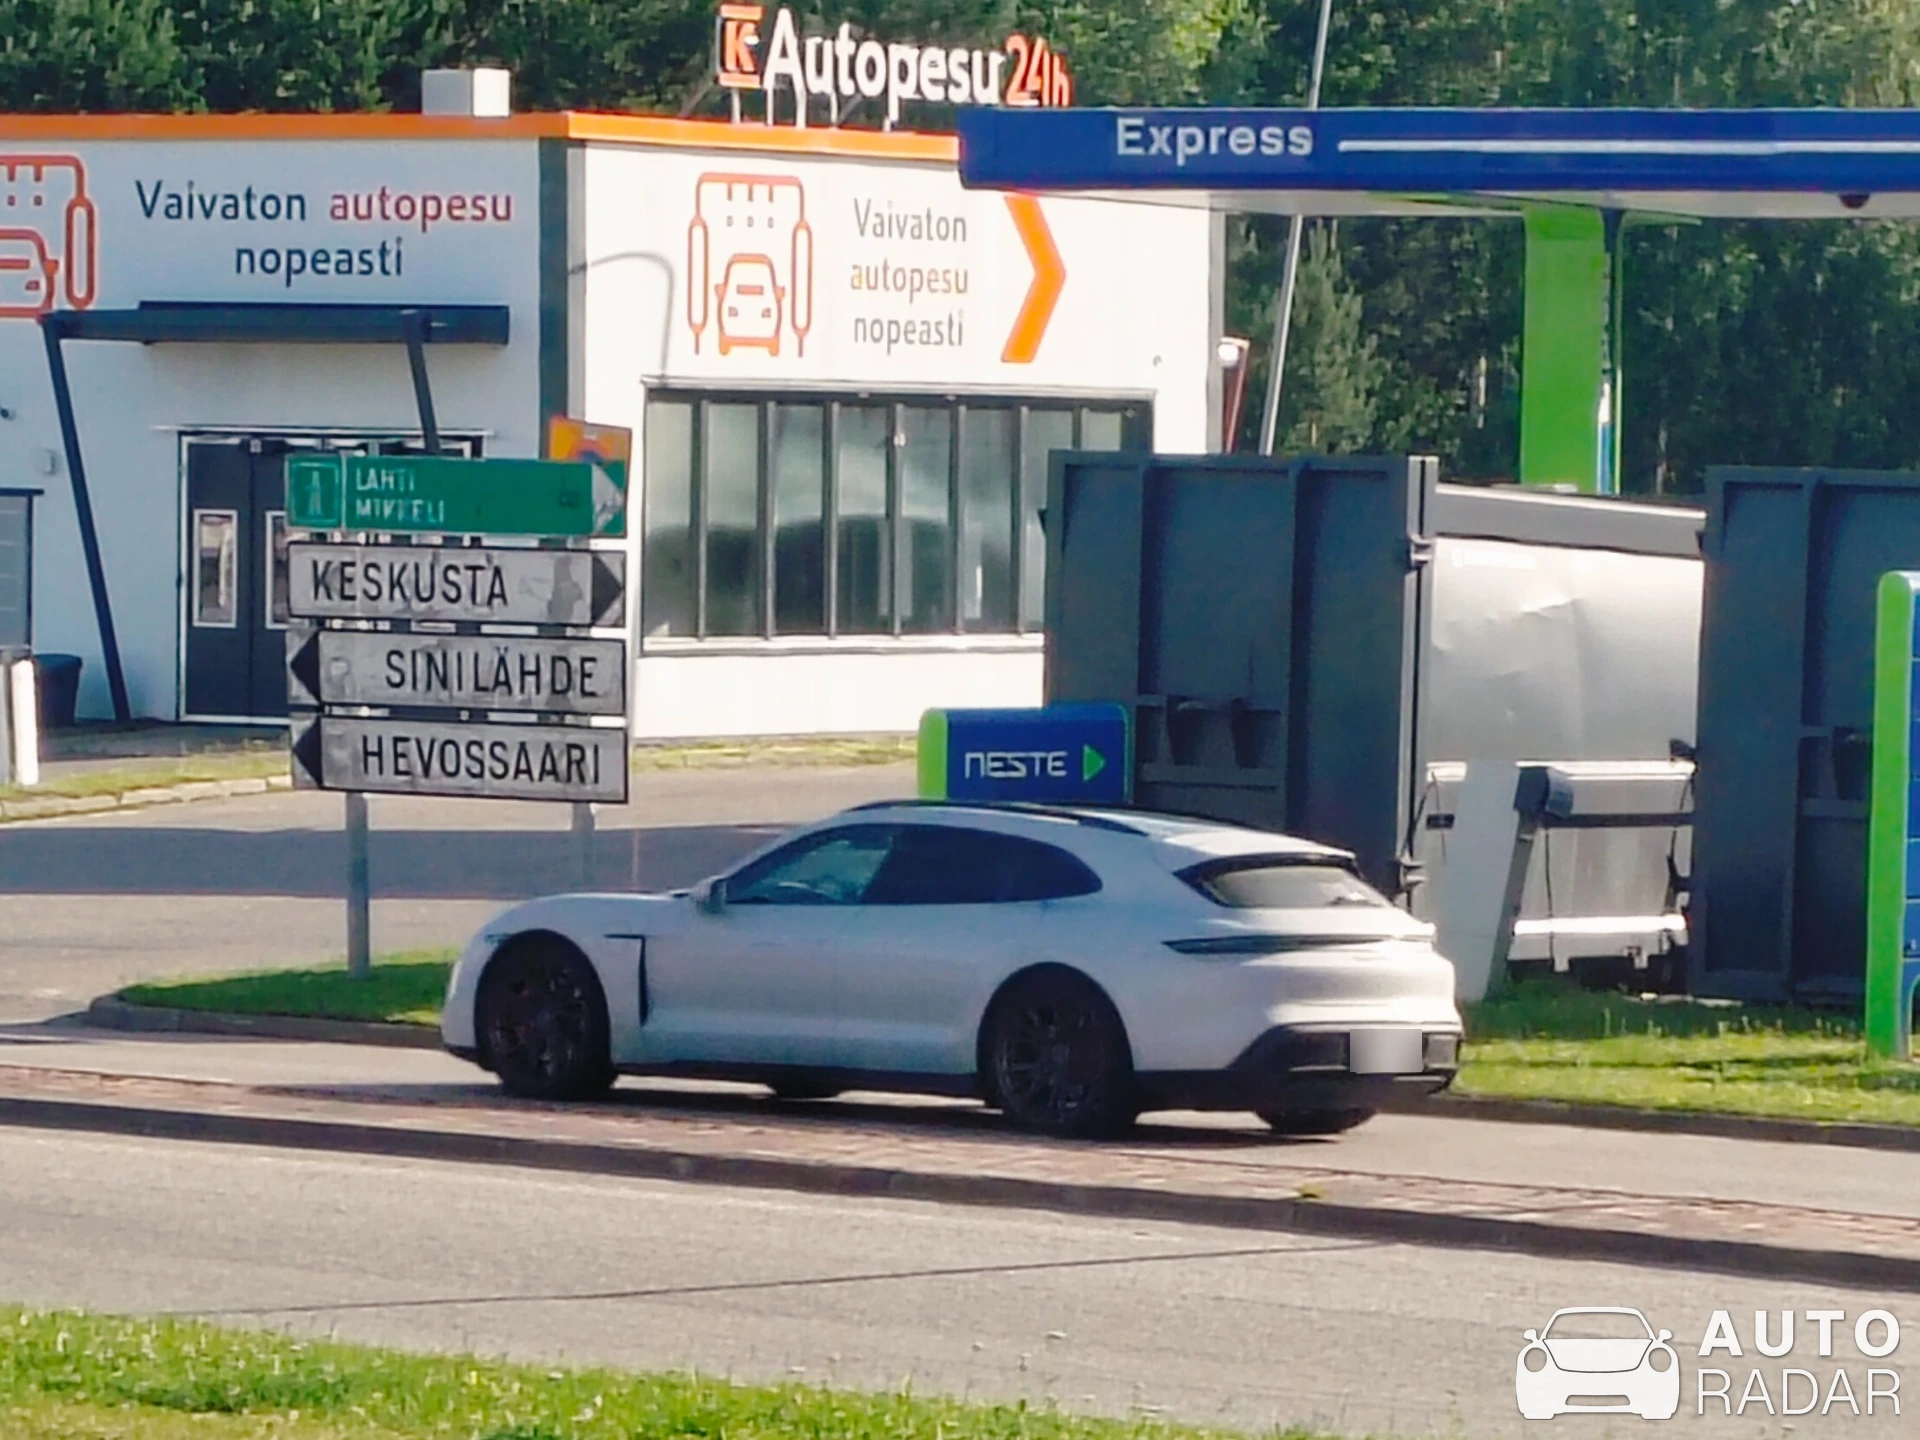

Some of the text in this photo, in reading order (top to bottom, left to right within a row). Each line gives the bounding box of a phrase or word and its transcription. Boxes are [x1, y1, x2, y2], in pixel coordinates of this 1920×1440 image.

[763, 8, 1004, 121] Autopesu
[1003, 33, 1074, 107] 24h
[1116, 116, 1314, 166] Express
[135, 179, 513, 233] Vaivaton autopesu
[853, 197, 967, 242] Vaivaton
[235, 236, 404, 287] nopeasti
[850, 257, 969, 304] autopesu
[854, 308, 965, 356] nopeasti
[355, 467, 416, 492] LAHTI
[312, 559, 509, 607] KESKUSTA
[385, 645, 599, 698] SINILÄHDE
[361, 733, 600, 785] HEVOSSAARI
[965, 751, 1068, 779] NESTE
